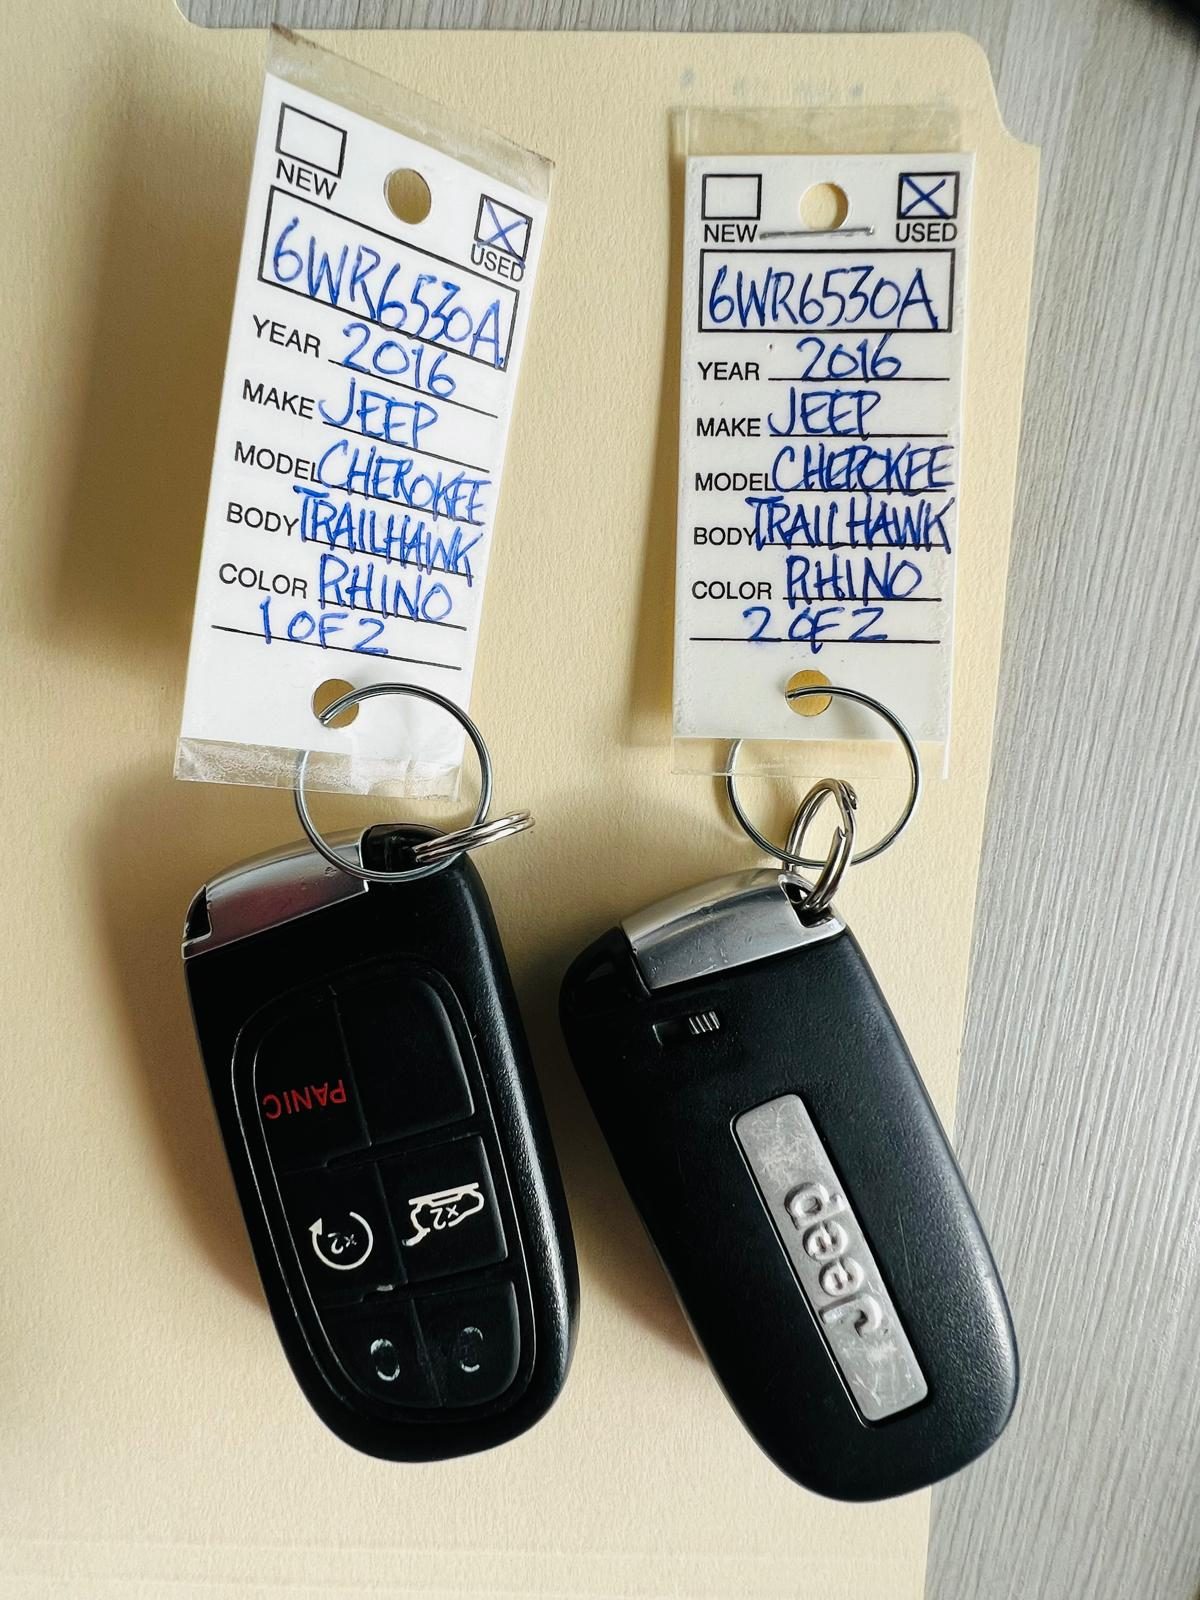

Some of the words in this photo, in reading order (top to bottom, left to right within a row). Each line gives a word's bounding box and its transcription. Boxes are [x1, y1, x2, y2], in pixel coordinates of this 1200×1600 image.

[276, 158, 337, 200] NEW
[703, 224, 758, 243] NEW
[895, 223, 958, 243] USED
[471, 243, 525, 282] USED
[273, 216, 505, 369] 6WR6530A
[709, 264, 939, 331] 6WR6530A
[252, 315, 321, 357] YEAR
[796, 331, 901, 383] 2016
[342, 323, 457, 398] 2016
[697, 361, 760, 381] YEAR
[242, 378, 315, 419] MAKE
[319, 377, 438, 449] JEEP
[767, 386, 881, 441] JEEP
[696, 418, 761, 437] MAKE
[234, 441, 321, 483] MODEL
[317, 439, 492, 525] CHEROKEE
[695, 473, 776, 492] MODEL
[772, 442, 955, 496] CHEROKEE
[226, 502, 300, 538] BODY
[293, 485, 483, 587] TRAILHAWK
[693, 527, 757, 546] BODY
[745, 493, 955, 554] TRAILHAWK
[218, 562, 308, 599] COLOR
[319, 553, 453, 622] RHINO
[691, 581, 772, 600] COLOR
[786, 552, 922, 609] RHINO
[260, 596, 273, 644] 1
[287, 610, 349, 649] OF
[353, 618, 389, 655] 2
[743, 606, 781, 642] 2
[788, 606, 845, 654] OF
[849, 607, 888, 641] 2
[263, 1079, 346, 1120] PANIC
[783, 1181, 882, 1338] Jeep
